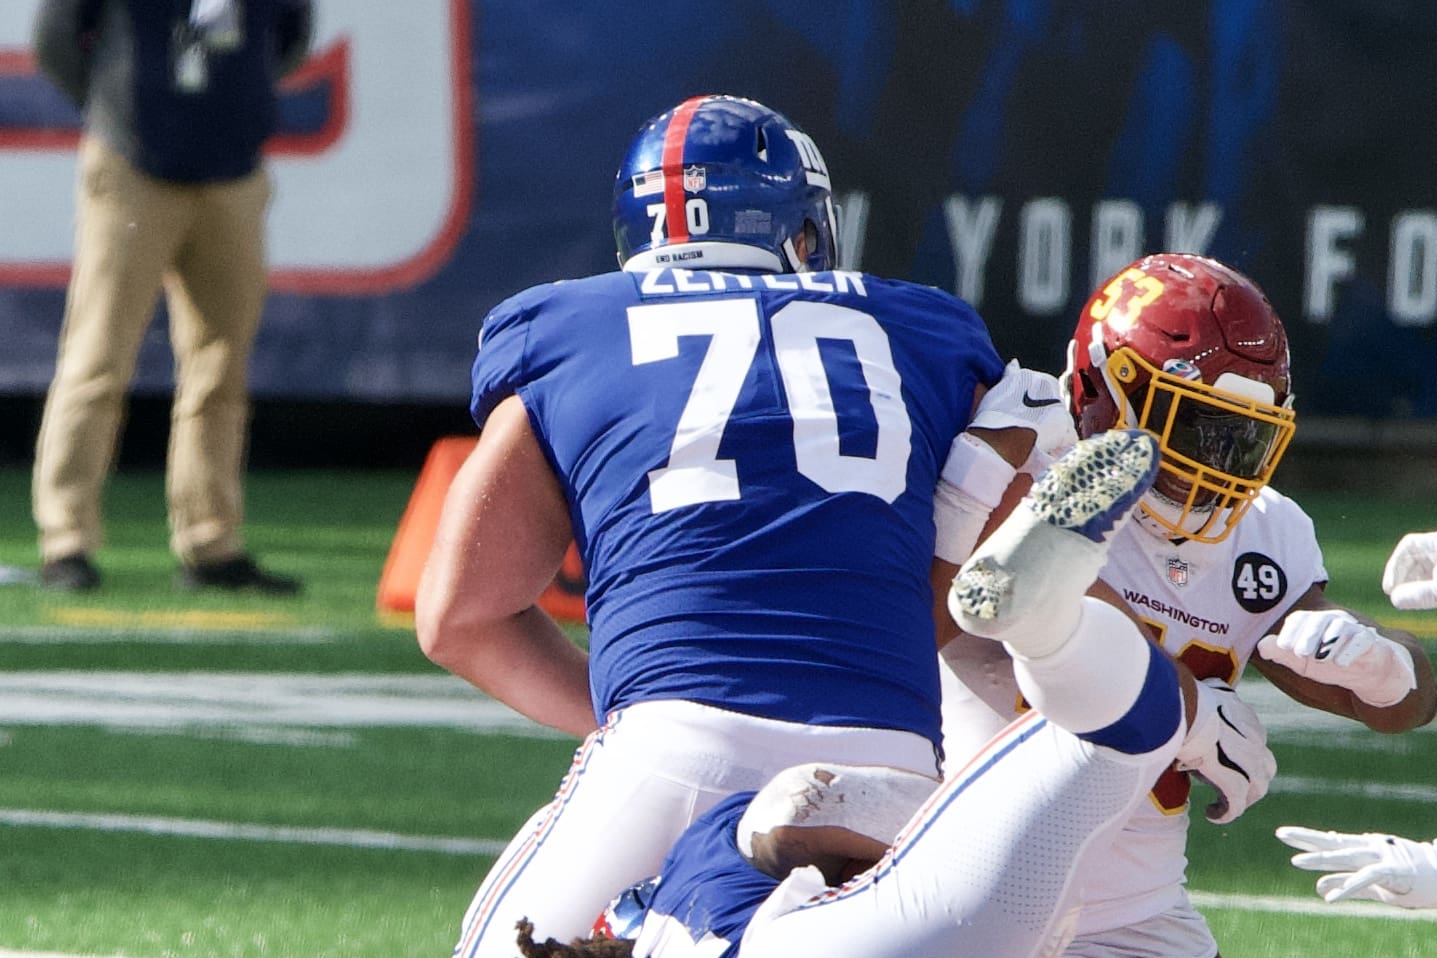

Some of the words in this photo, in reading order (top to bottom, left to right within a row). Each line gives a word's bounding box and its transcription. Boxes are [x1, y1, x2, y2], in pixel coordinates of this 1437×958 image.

[647, 198, 710, 249] 70
[1090, 267, 1165, 334] 53
[626, 297, 913, 515] 70
[1236, 562, 1281, 601] 49
[1123, 588, 1230, 635] WASHINGTON
